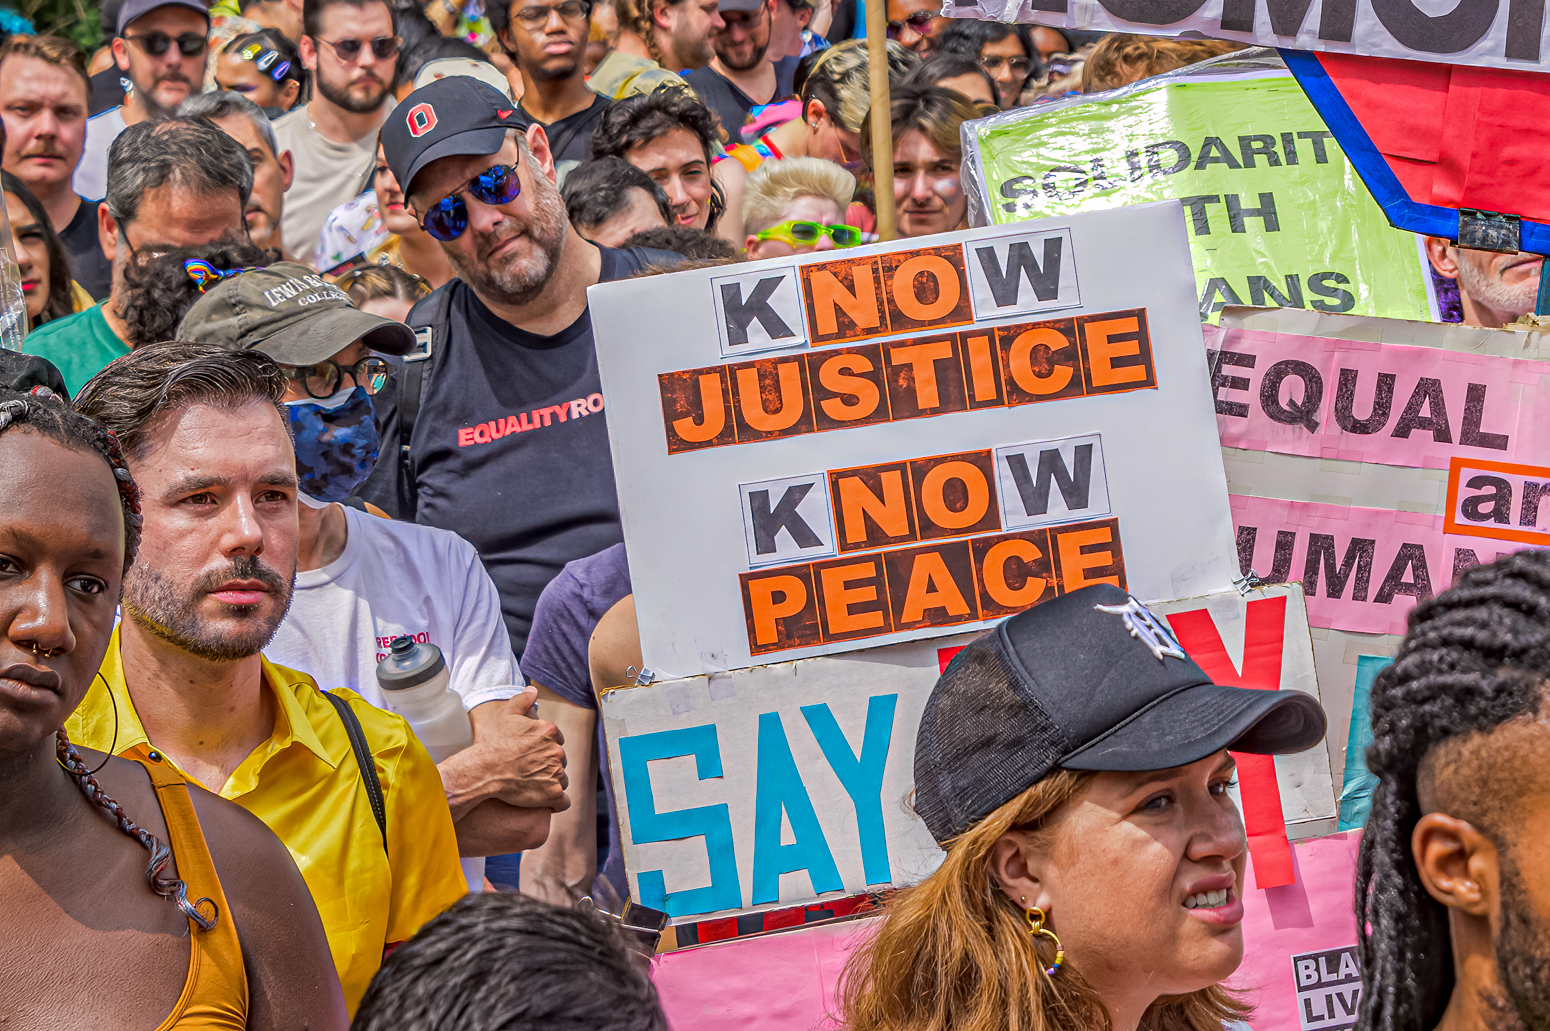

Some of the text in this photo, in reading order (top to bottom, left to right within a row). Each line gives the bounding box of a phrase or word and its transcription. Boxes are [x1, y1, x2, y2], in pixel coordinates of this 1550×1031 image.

[720, 237, 1064, 348] KNOW
[671, 316, 1149, 443] JUSTICE
[1207, 348, 1510, 451] EQUAL
[748, 443, 1094, 556] KNOW
[748, 527, 1121, 647] PEACE
[618, 692, 898, 917] SAY
